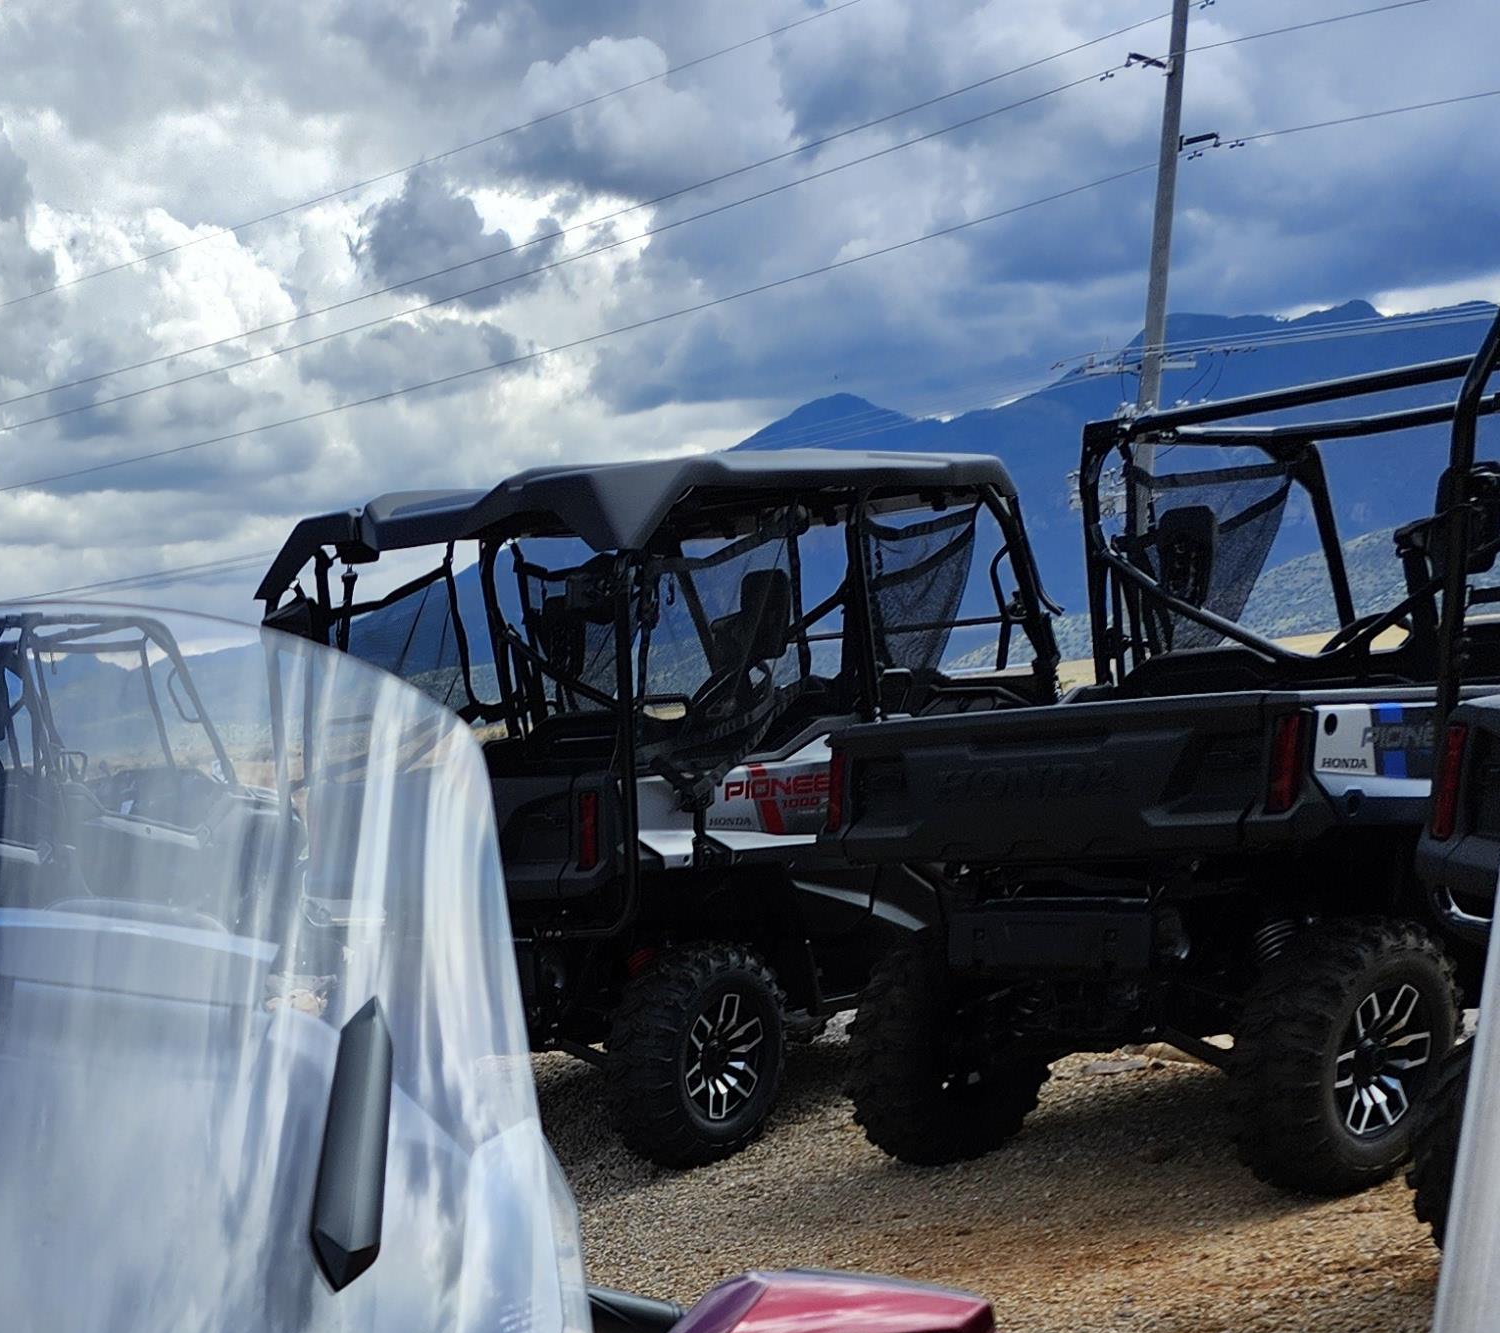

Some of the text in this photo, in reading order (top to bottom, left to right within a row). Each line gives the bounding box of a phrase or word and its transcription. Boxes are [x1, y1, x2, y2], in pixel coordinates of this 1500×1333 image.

[1361, 722, 1436, 748] PIONE
[1322, 758, 1368, 769] HONDA
[725, 774, 830, 801] PIONEE
[782, 798, 820, 808] 1000
[709, 816, 752, 826] HONDA
